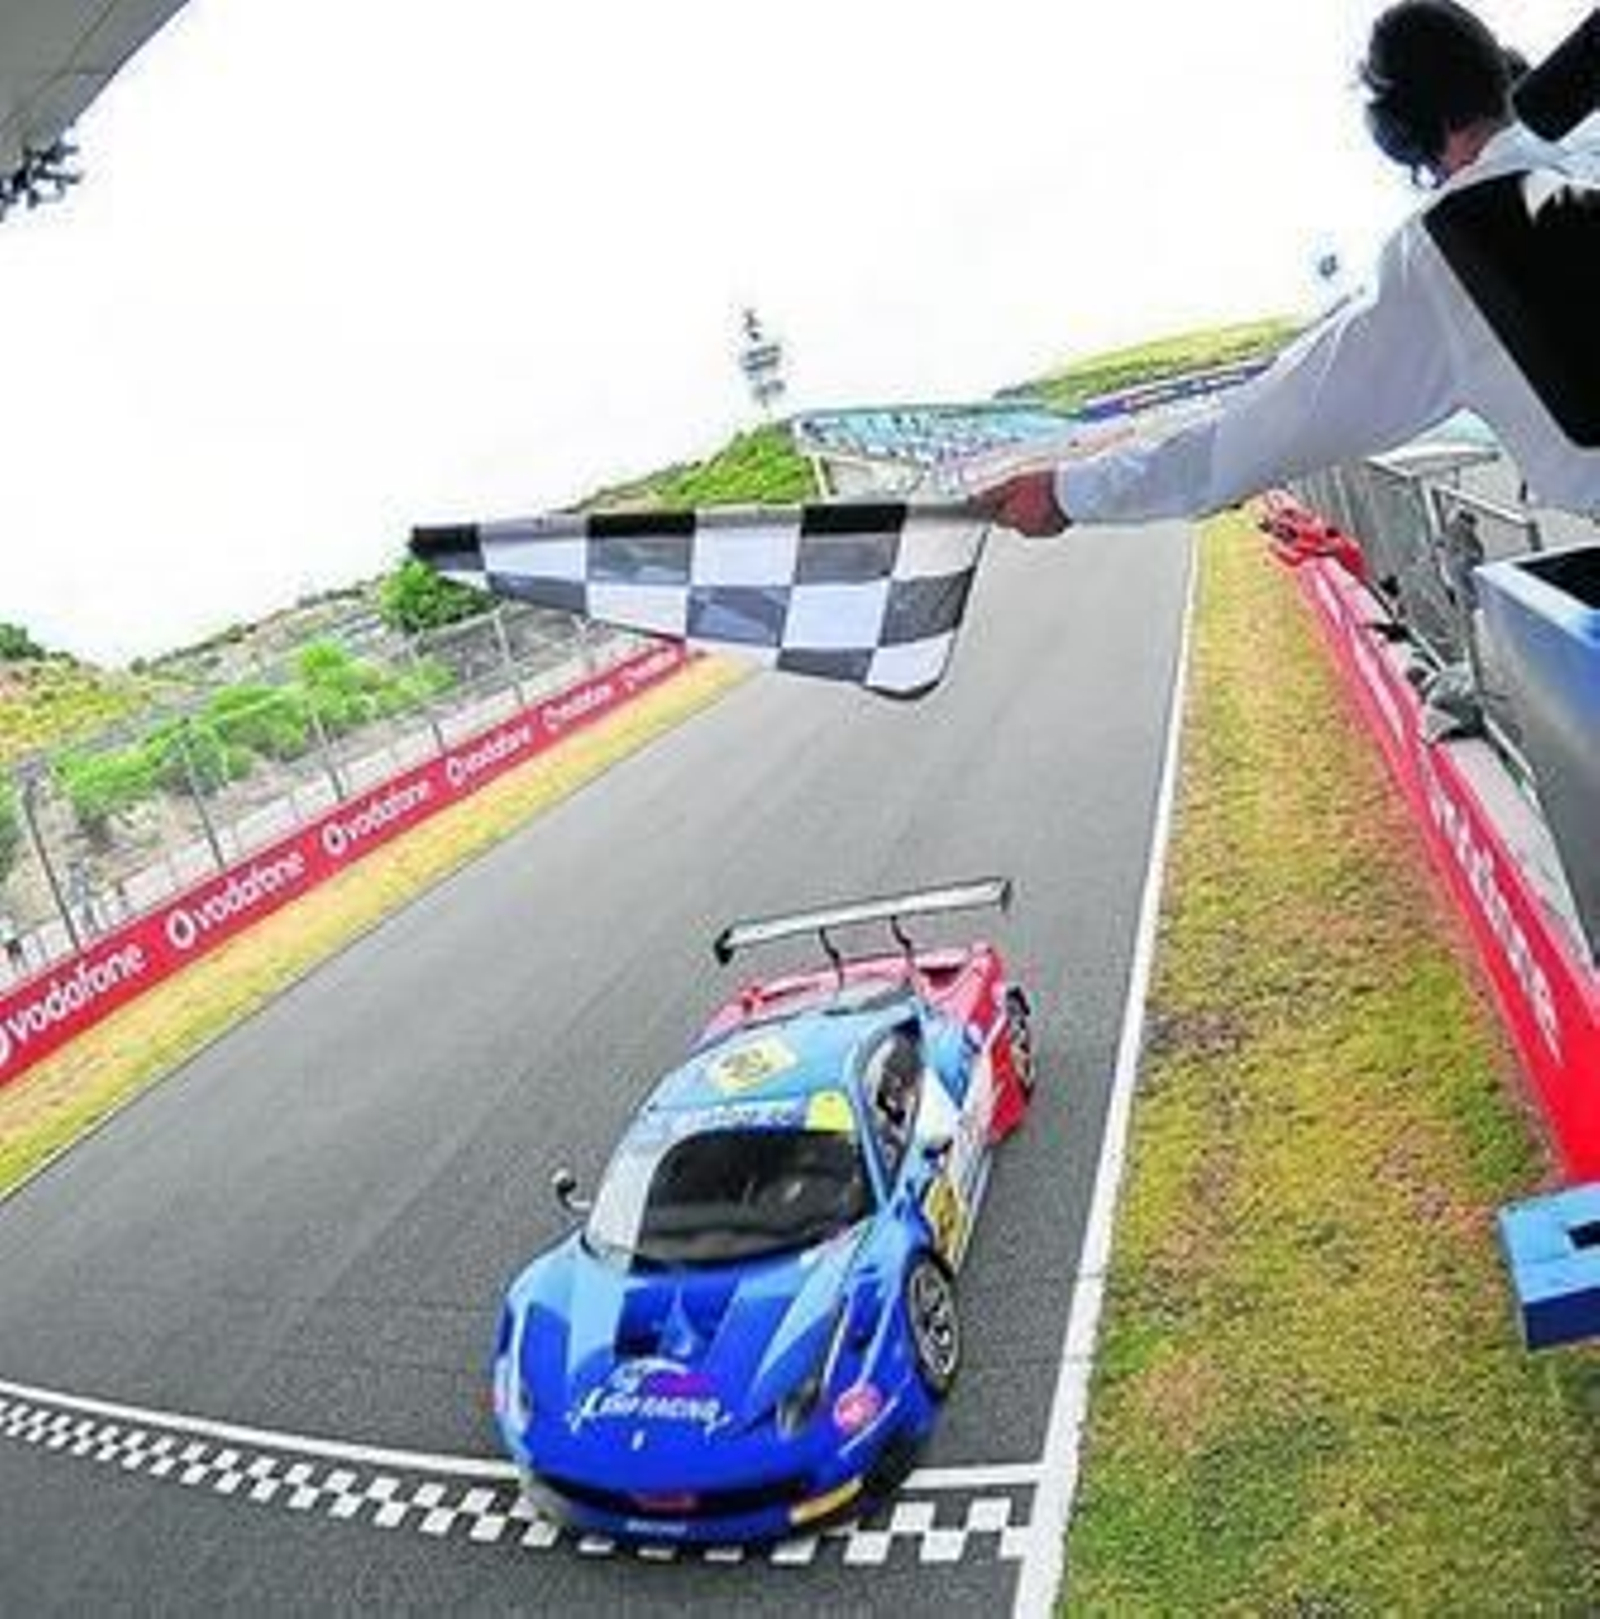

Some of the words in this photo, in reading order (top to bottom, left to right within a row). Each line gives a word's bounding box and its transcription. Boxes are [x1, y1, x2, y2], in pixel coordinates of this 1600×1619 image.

[342, 780, 429, 840] vodafone
[193, 851, 305, 930] vodafone
[6, 943, 147, 1043] vodafone
